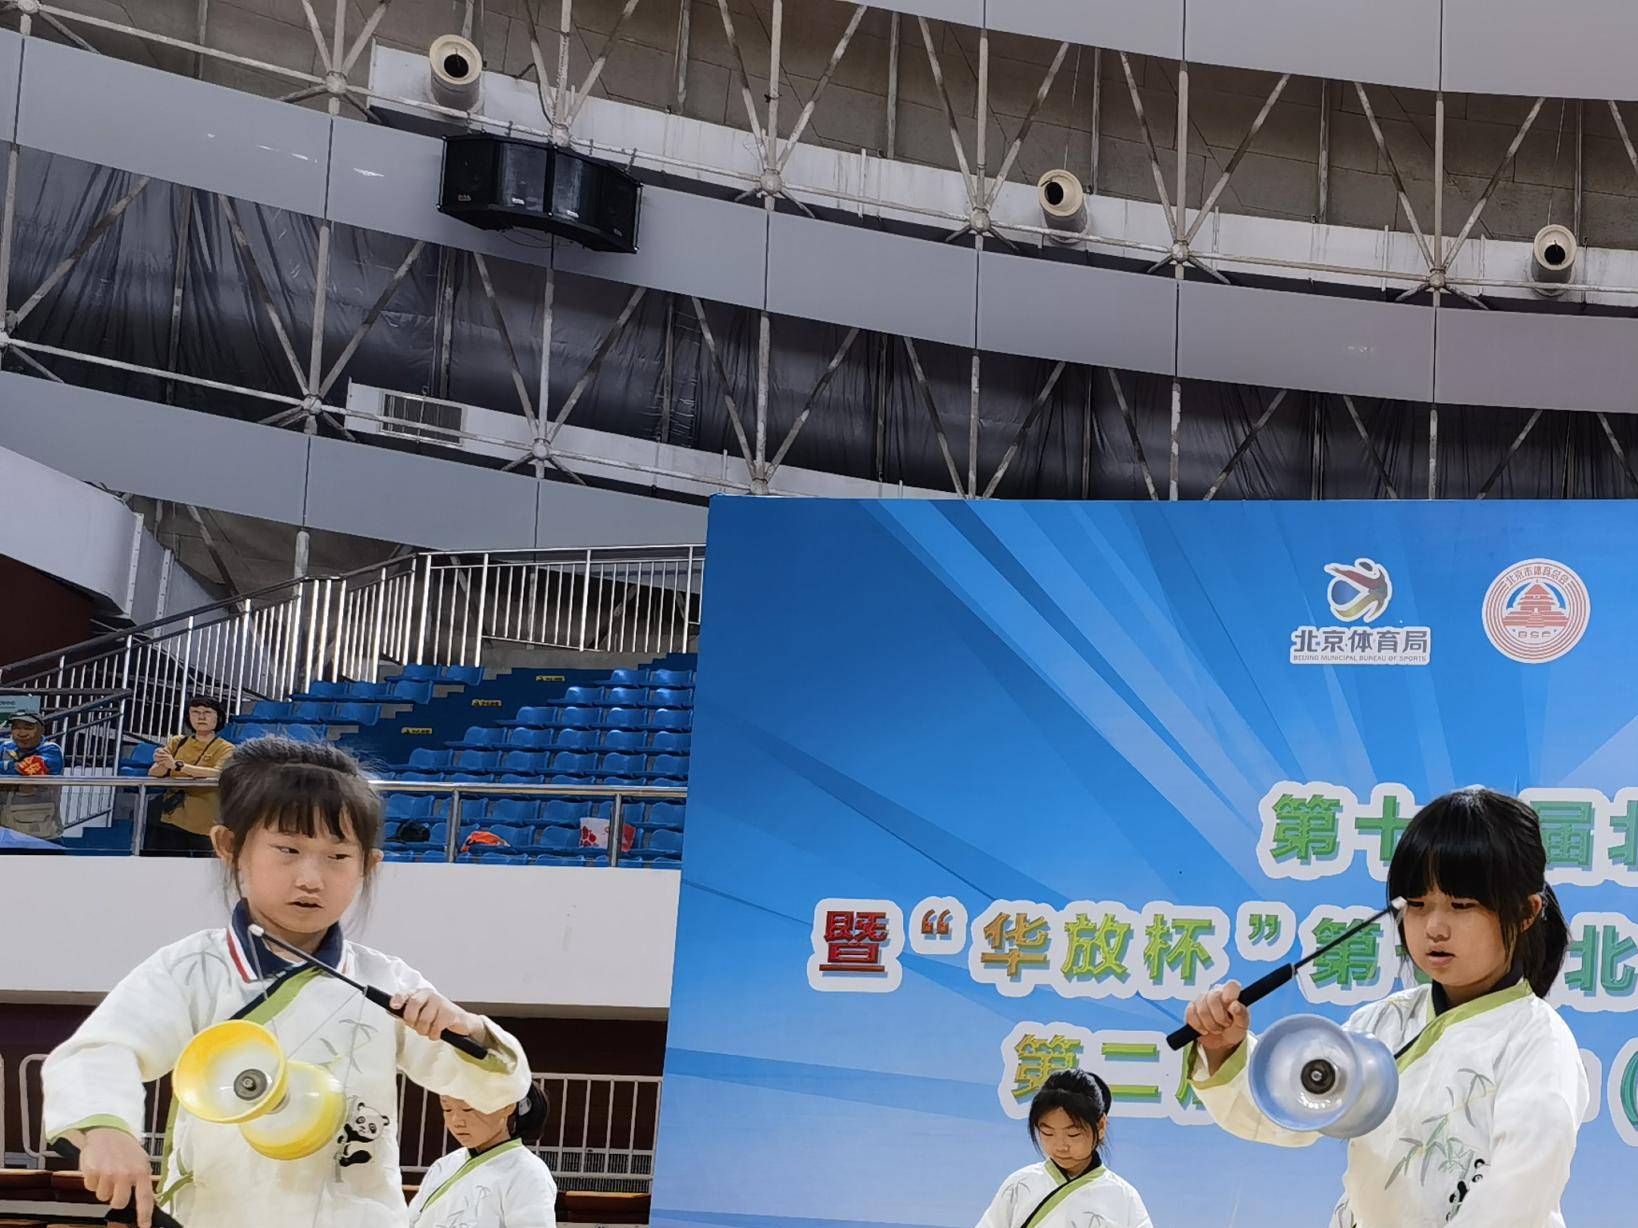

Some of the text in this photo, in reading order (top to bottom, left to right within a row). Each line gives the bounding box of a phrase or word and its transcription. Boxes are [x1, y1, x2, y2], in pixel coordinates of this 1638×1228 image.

[1294, 630, 1428, 653] 北京体育局
